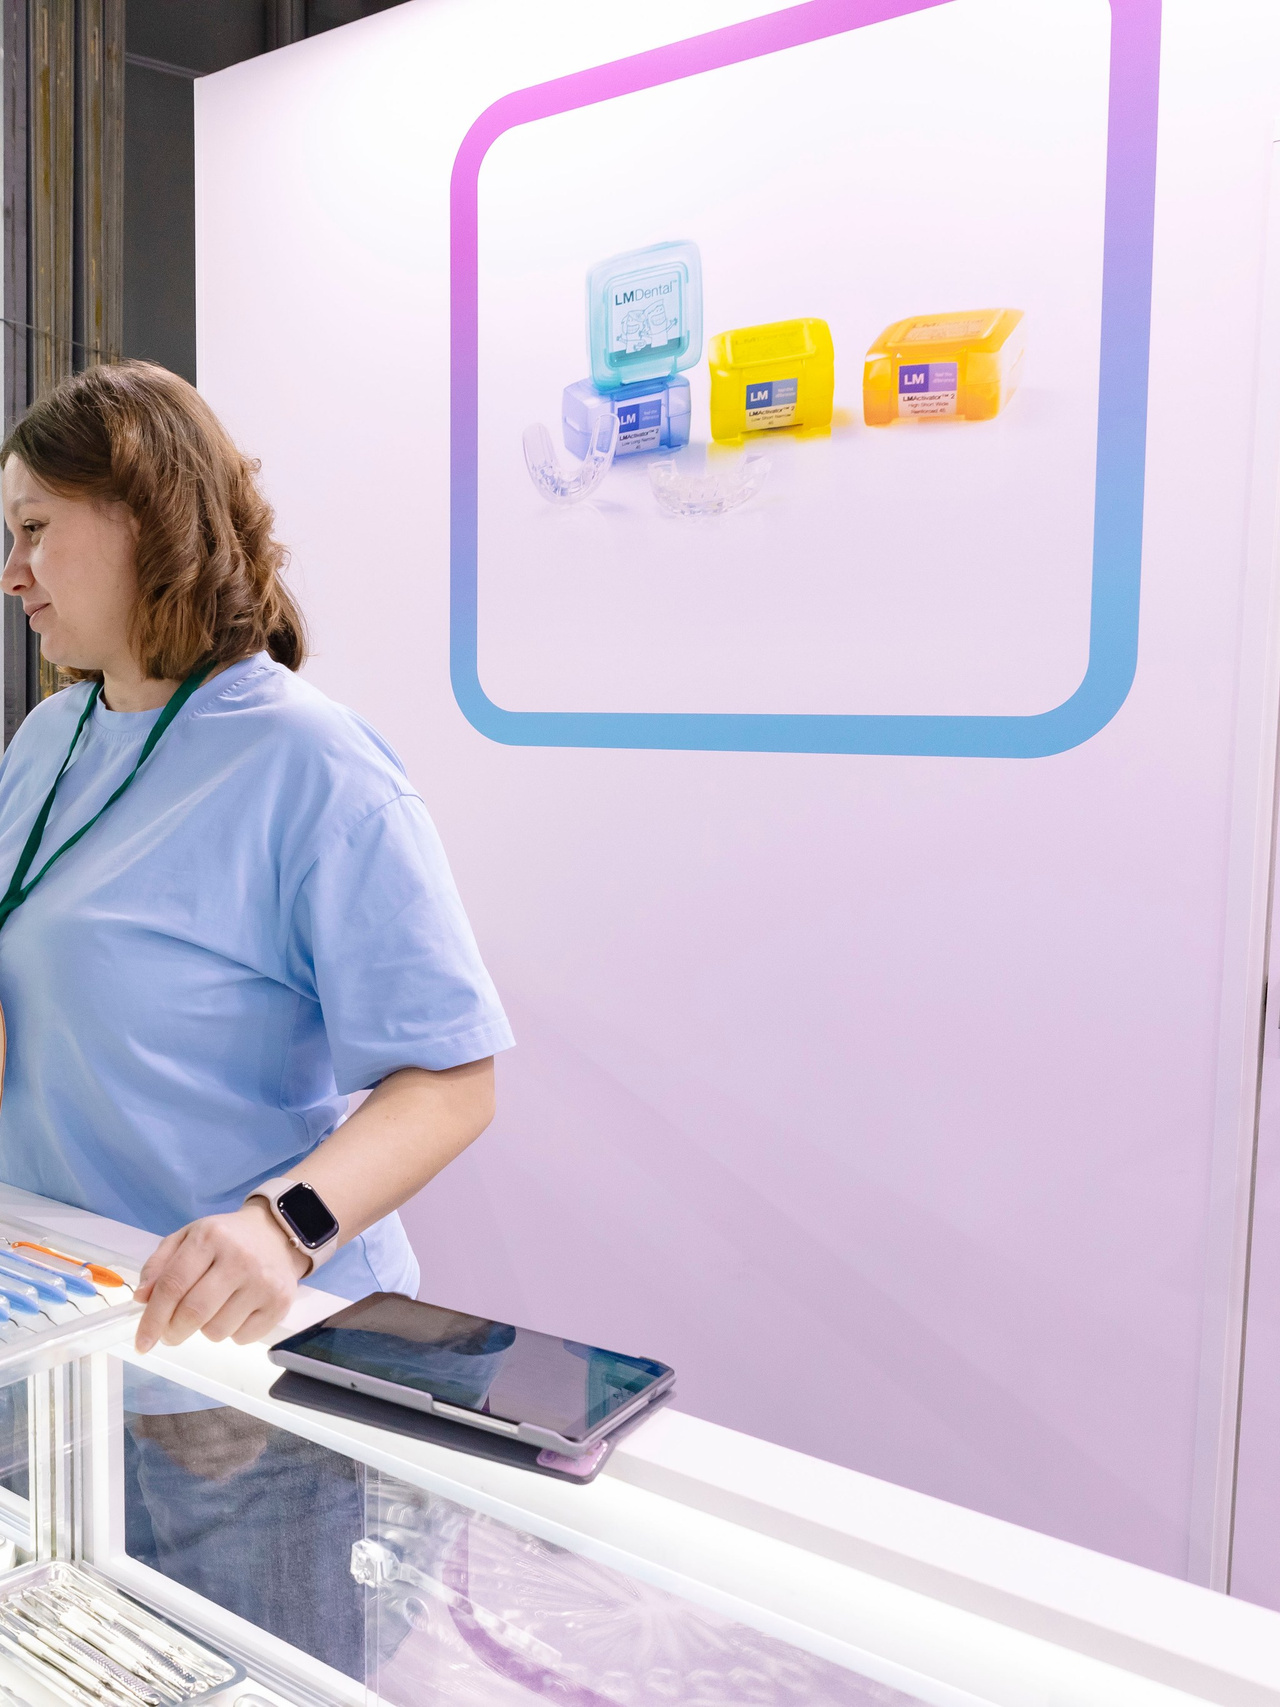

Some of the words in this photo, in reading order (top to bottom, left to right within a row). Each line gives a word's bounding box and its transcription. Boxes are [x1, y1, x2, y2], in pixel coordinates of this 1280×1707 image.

[904, 373, 924, 385] LM
[750, 390, 768, 402] LM
[620, 413, 636, 425] LM
